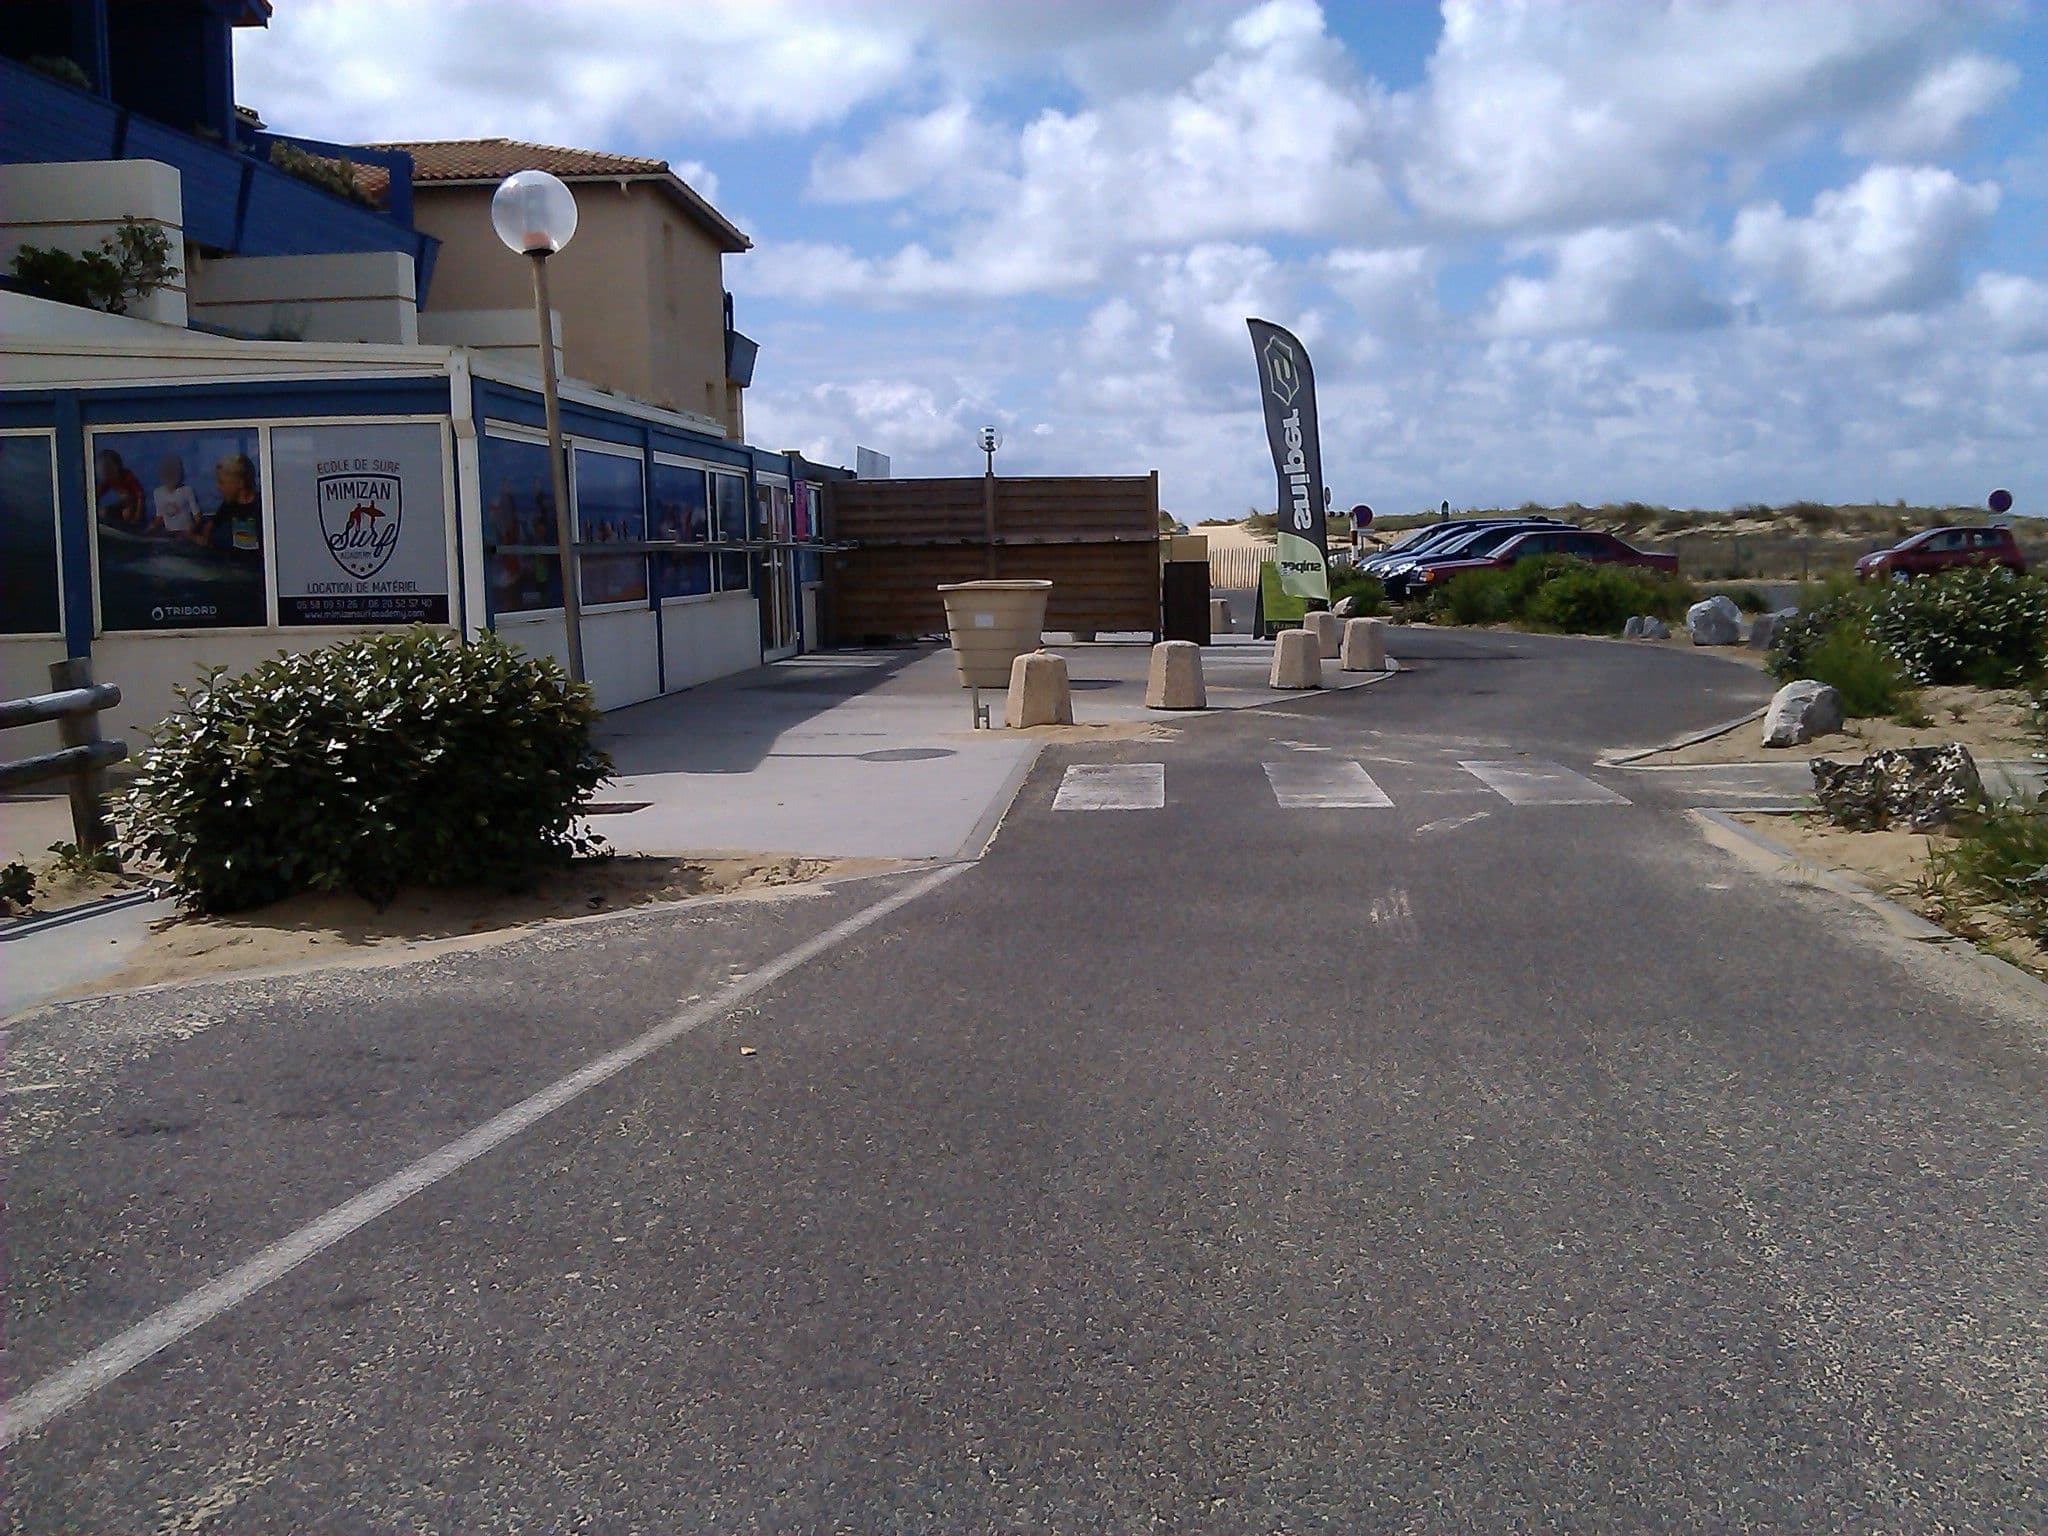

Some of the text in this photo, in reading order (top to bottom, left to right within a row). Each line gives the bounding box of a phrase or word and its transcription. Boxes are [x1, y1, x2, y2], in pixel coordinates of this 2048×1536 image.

[354, 459, 368, 470] DE
[372, 459, 399, 472] SURF
[325, 481, 391, 501] MIMIZAN
[329, 520, 396, 557] Surf
[307, 580, 418, 594] LOCATION DE MATÉRIEL
[165, 606, 217, 616] TRIBORD
